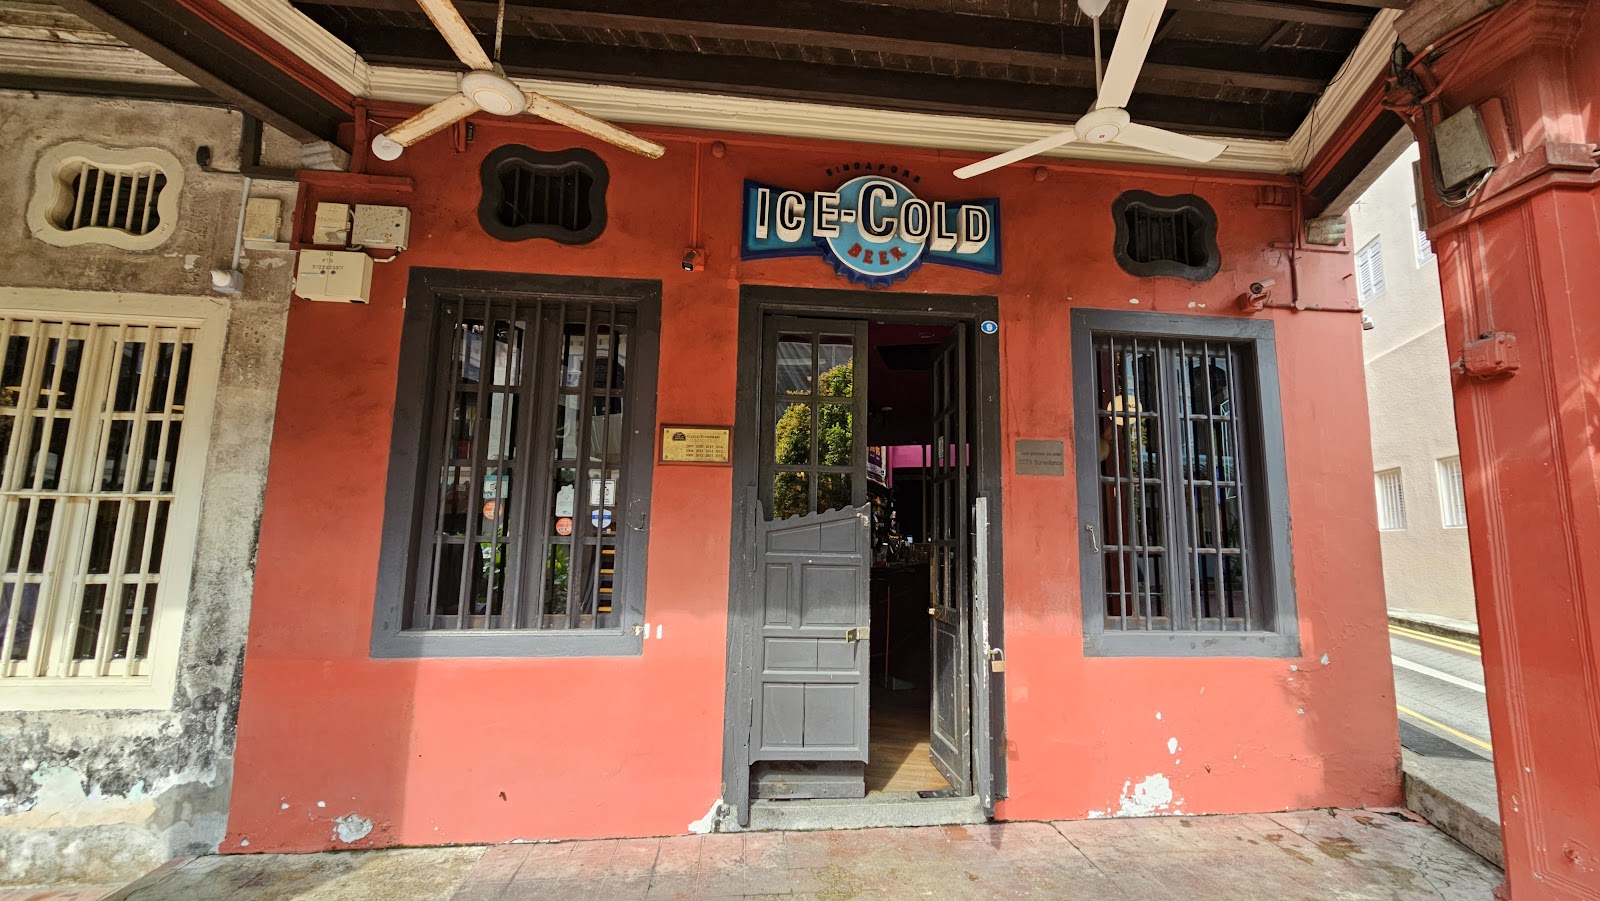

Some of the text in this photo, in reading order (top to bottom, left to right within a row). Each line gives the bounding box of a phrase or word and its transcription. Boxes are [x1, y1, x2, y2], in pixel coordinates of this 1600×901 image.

[825, 162, 921, 183] SINGAPORE
[755, 180, 991, 254] ICE-COLD
[847, 242, 907, 266] BEER
[986, 323, 993, 331] 9
